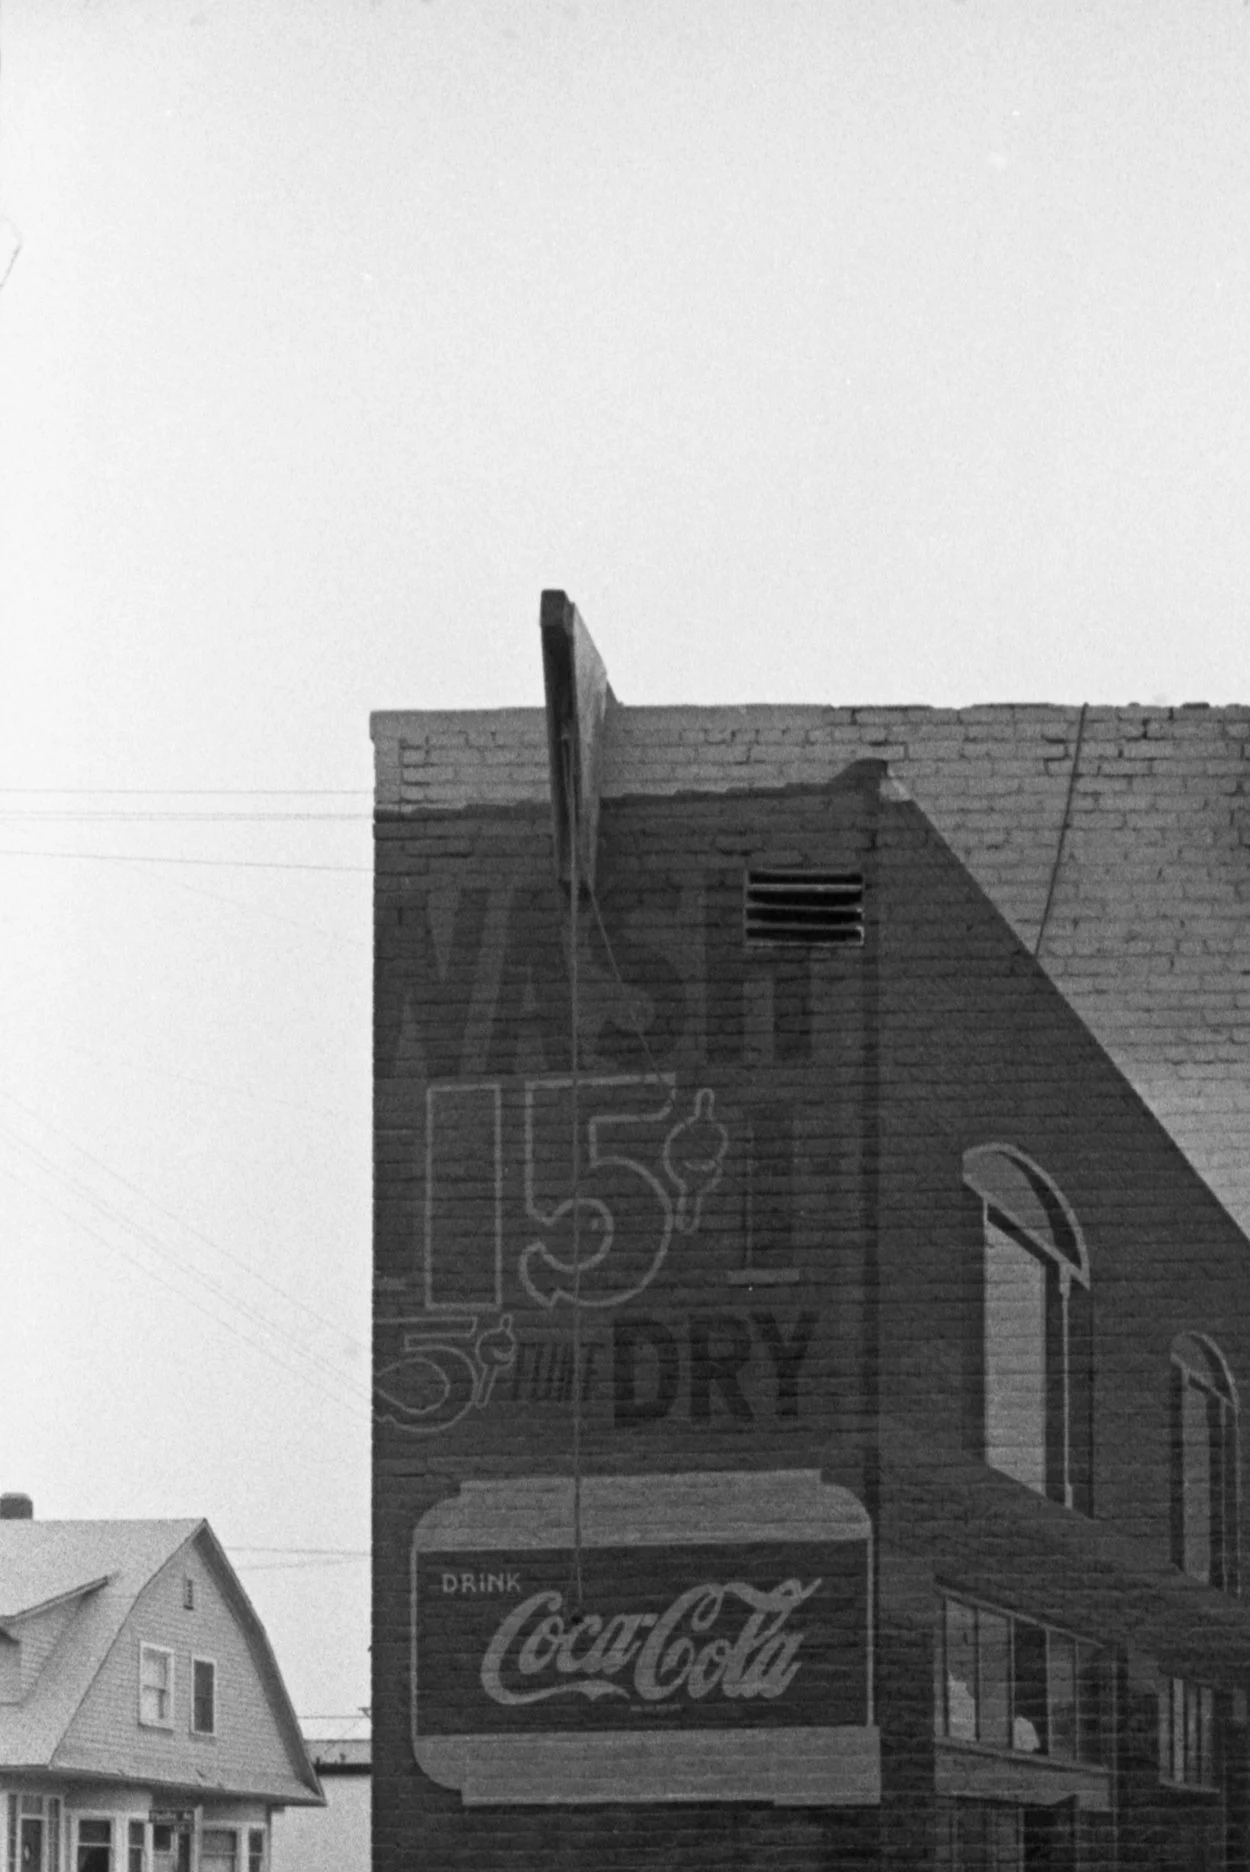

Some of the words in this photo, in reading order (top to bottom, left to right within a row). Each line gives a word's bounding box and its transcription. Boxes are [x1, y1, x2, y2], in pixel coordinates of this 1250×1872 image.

[376, 874, 812, 1078] WASH
[613, 1311, 819, 1428] DRY
[441, 1572, 523, 1595] DRINK
[479, 1577, 824, 1706] Coca-Cola
